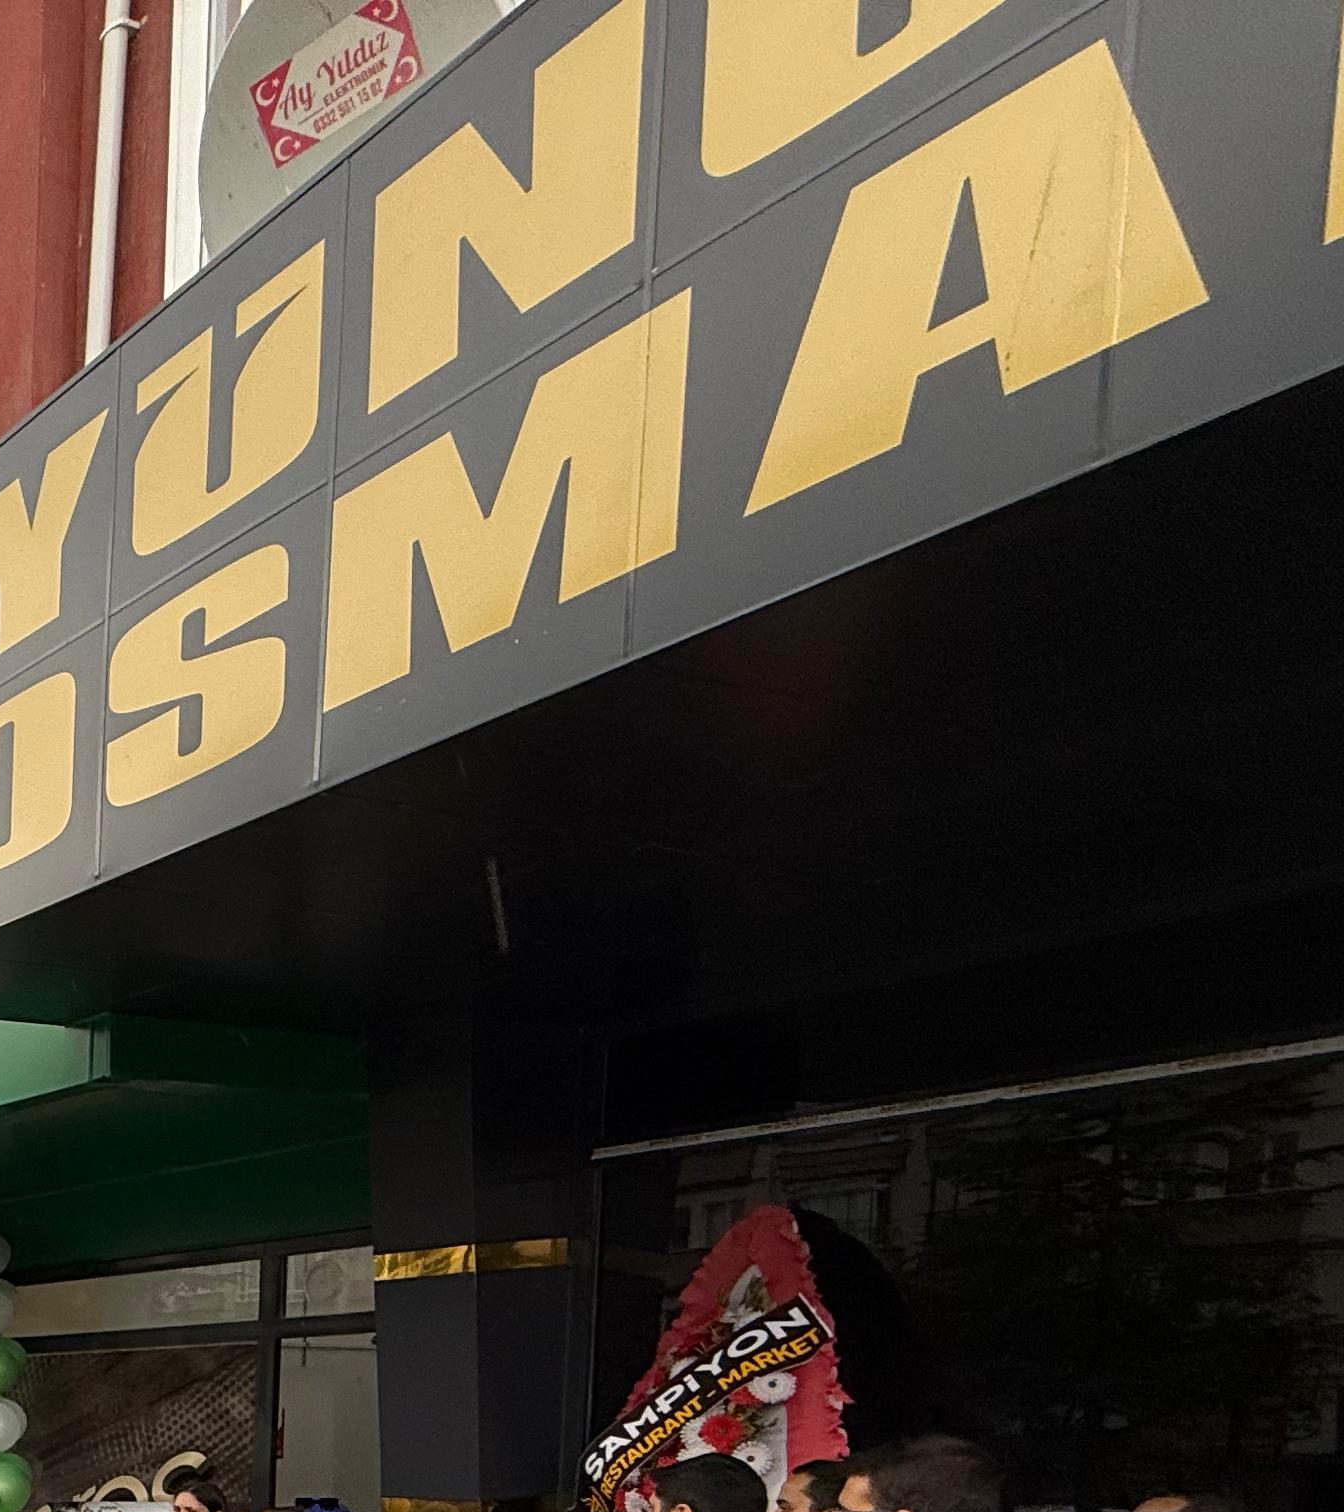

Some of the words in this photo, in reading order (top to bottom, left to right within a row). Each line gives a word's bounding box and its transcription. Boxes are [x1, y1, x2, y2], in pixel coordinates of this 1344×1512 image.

[279, 82, 314, 120] Ay
[600, 1394, 703, 1500] RESTAURANT
[718, 1328, 821, 1392] MARKET
